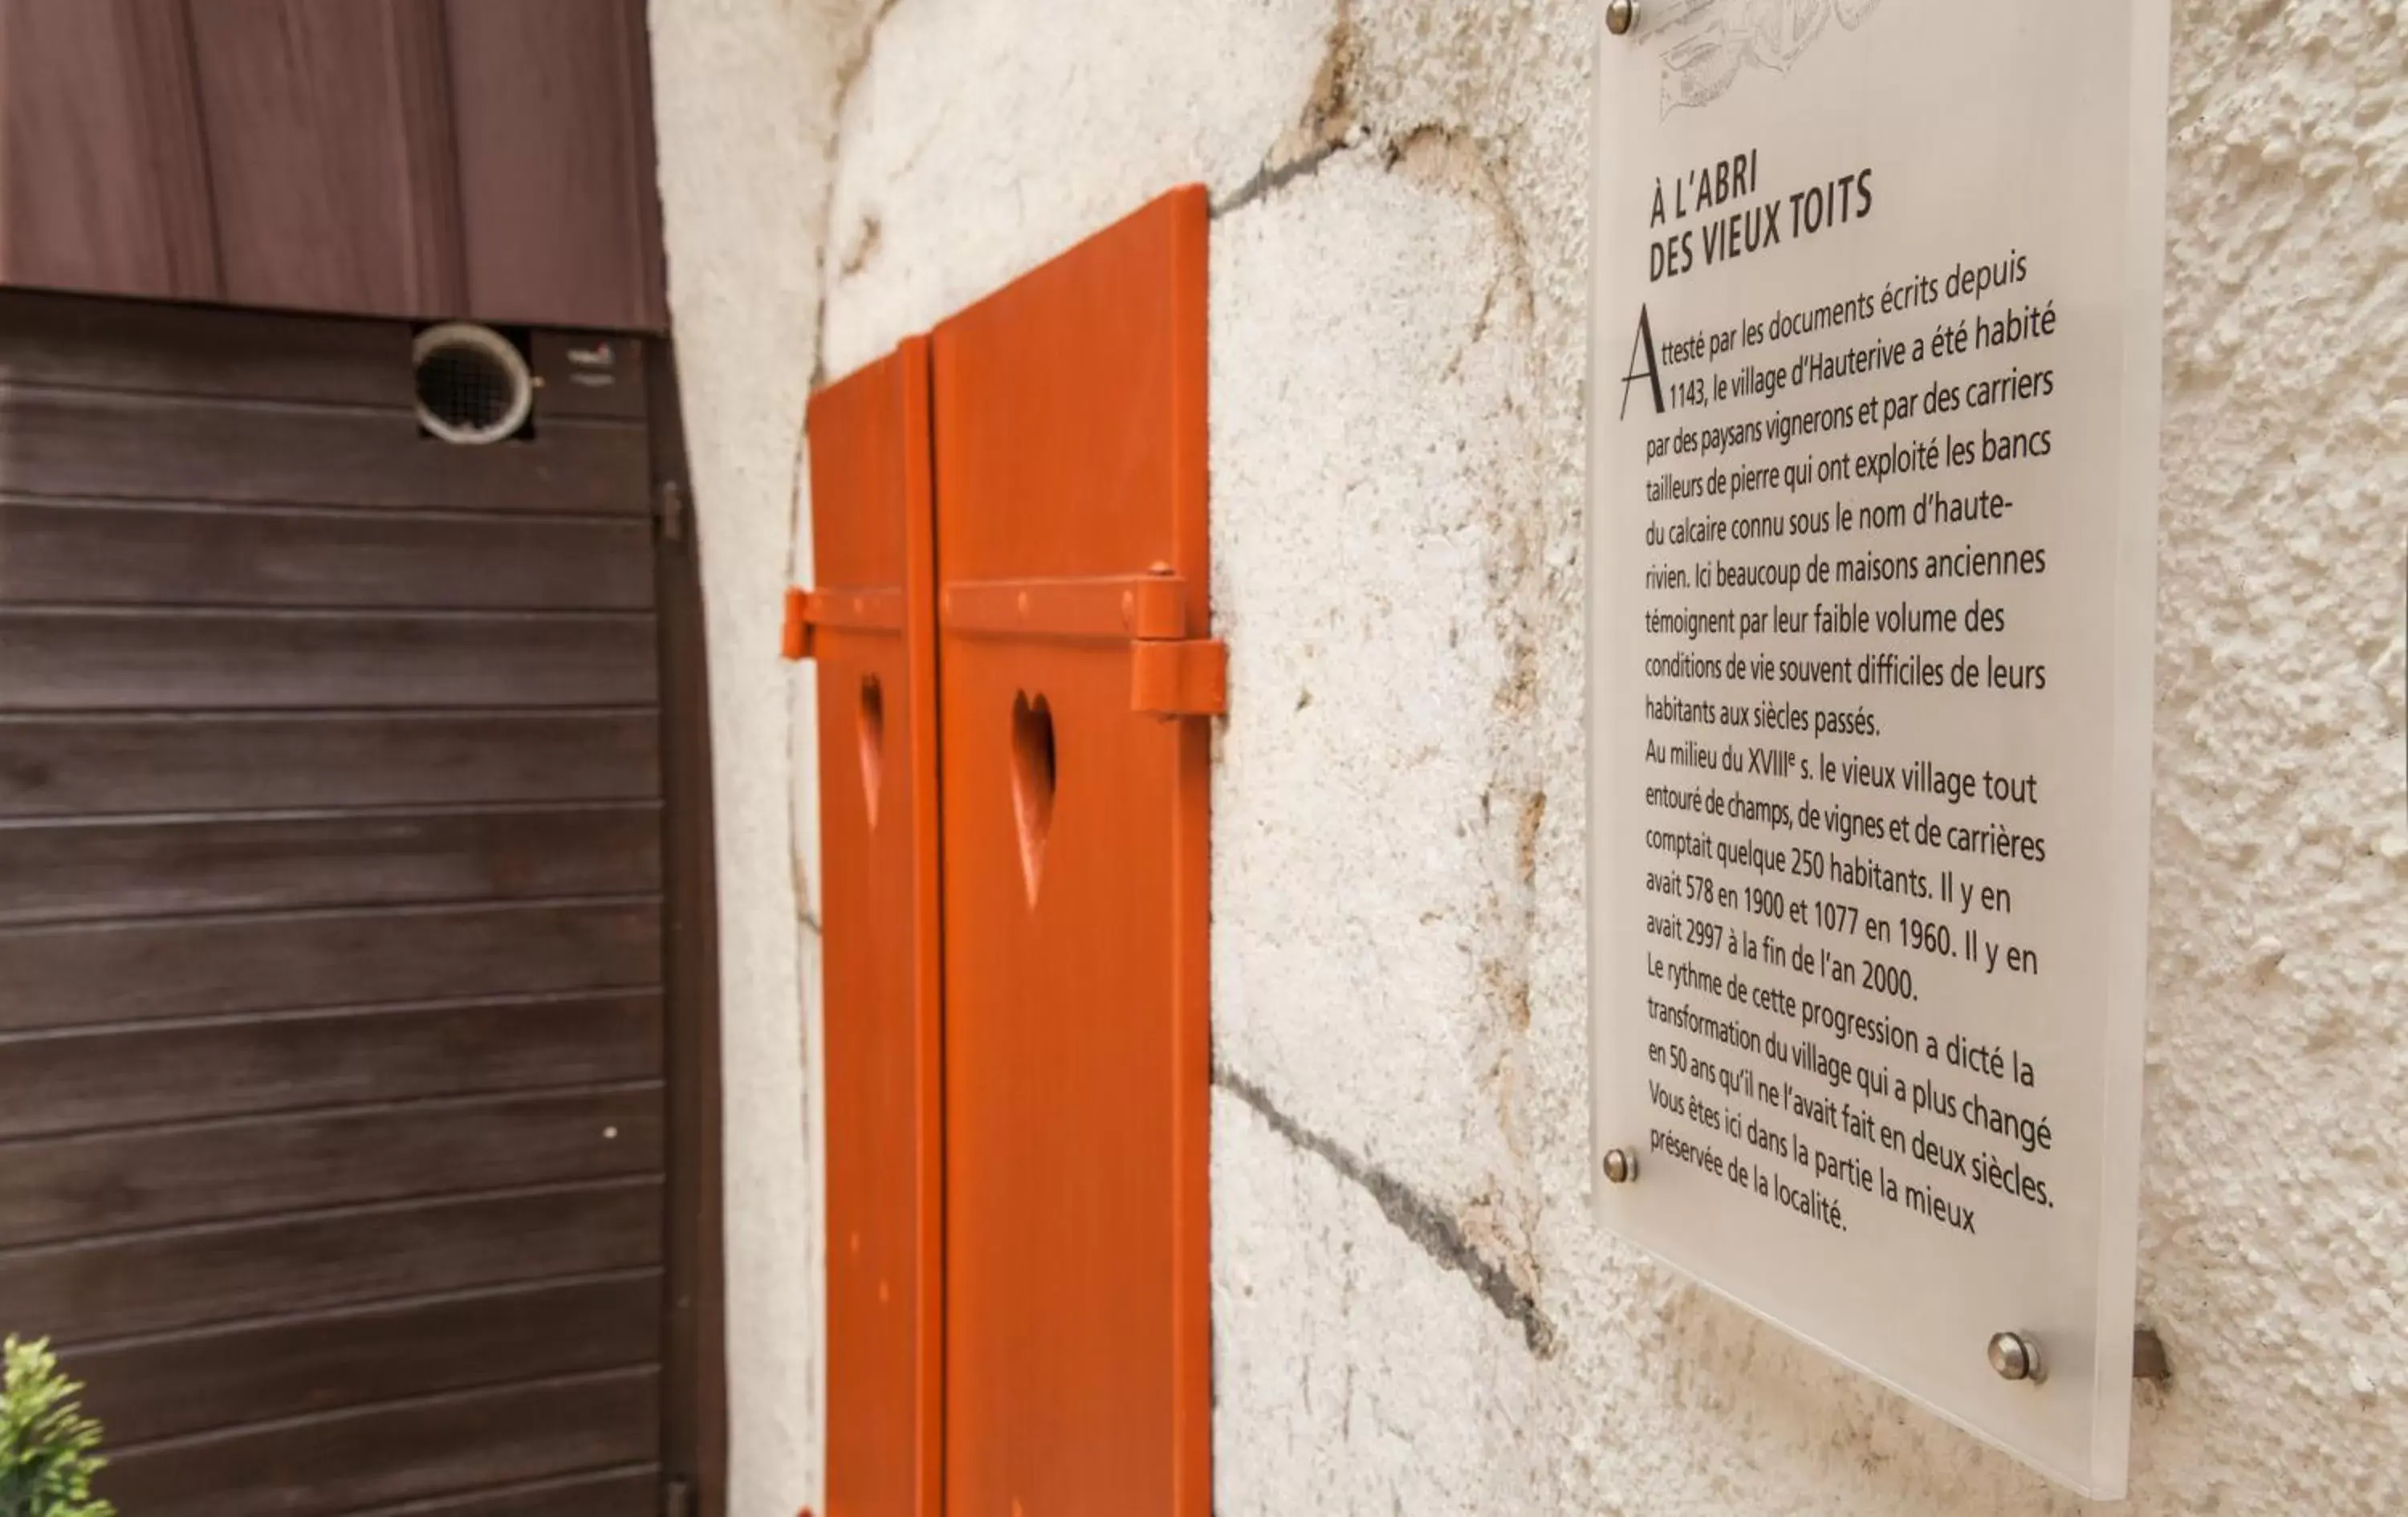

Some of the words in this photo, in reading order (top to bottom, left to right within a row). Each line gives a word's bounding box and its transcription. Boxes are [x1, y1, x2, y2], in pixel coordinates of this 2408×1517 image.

[1649, 177, 1666, 230] À
[1675, 148, 1758, 219] L’ABRI
[1649, 230, 1694, 283] DES
[1702, 199, 1781, 266] VIEUX
[1788, 167, 1873, 239] TOITS
[1709, 328, 1738, 363] par
[1741, 317, 1764, 348] les
[1768, 291, 1874, 341] documents
[1881, 274, 1938, 315] écrits
[1945, 248, 2028, 301] depuis
[1670, 377, 1709, 409] 1143,
[1713, 372, 1728, 401] le
[1731, 364, 1788, 400] village
[1791, 337, 1906, 386] d’Hauterive
[1911, 337, 1925, 363] a
[1930, 319, 1969, 358] été
[1975, 299, 2056, 350] habité
[1646, 436, 1670, 466] par
[1673, 426, 1698, 455] des
[1701, 420, 1763, 458] paysans
[1765, 404, 1854, 446] vignerons
[1857, 396, 1879, 426] et
[1883, 392, 1919, 431] par
[1922, 380, 1961, 416] des
[1965, 366, 2054, 409] carriers
[1645, 473, 1704, 502] tailleurs
[1706, 466, 1727, 496] de
[1731, 463, 1780, 500] pierre
[1784, 453, 1812, 494] qui
[1816, 453, 1851, 483] ont
[1855, 436, 1940, 484] exploité
[1946, 433, 1975, 468] les
[1982, 428, 2052, 463] bancs
[1645, 519, 1665, 547] du
[1668, 514, 1727, 545] calcaire
[1731, 515, 1784, 540] connu
[1788, 510, 1830, 536] sous
[1836, 500, 1853, 532] le
[1859, 503, 1906, 531] nom
[1913, 490, 2014, 526] d’haute-
[1645, 563, 1690, 590] rivien.
[1695, 560, 1712, 588] Ici
[1716, 559, 1801, 592] beaucoup
[1805, 553, 1831, 584] de
[1836, 550, 1919, 583] maisons
[1924, 543, 2046, 579] anciennes
[1645, 607, 1736, 641] témoignent
[1739, 612, 1769, 641] par
[1773, 604, 1809, 634] leur
[1813, 602, 1870, 634] faible
[1875, 600, 1958, 633] volume
[1964, 598, 2005, 633] des
[1645, 650, 1723, 680] conditions
[1725, 651, 1747, 681] de
[1750, 652, 1775, 681] vie
[1779, 657, 1853, 685] souvent
[1857, 653, 1944, 687] difficiles
[1950, 654, 1980, 689] de
[1987, 654, 2046, 690] leurs
[1645, 693, 1716, 725] habitants
[1719, 705, 1750, 726] aux
[1753, 699, 1809, 732] siècles
[1814, 706, 1881, 740] passés.
[1645, 738, 1666, 764] Au
[1670, 740, 1718, 770] milieu
[1721, 744, 1743, 773] du
[1800, 758, 1814, 780] s.
[1820, 752, 1837, 783] le
[1841, 754, 1896, 790] vieux
[1901, 760, 1977, 805] village
[1982, 770, 2038, 805] tout
[1645, 784, 1702, 813] entouré
[1704, 787, 1725, 816] de
[1727, 790, 1793, 831] champs,
[1797, 799, 1821, 831] de
[1824, 803, 1885, 843] vignes
[1889, 815, 1910, 844] et
[1914, 813, 1942, 848] de
[1946, 822, 2046, 863] carrières
[1645, 828, 1714, 860] comptait
[1716, 838, 1786, 876] quelque
[1791, 847, 1824, 880] 250
[1829, 851, 1934, 900] habitants.
[1941, 870, 1953, 903] Il
[1959, 882, 1974, 915] y
[1980, 885, 2011, 914] en
[1645, 869, 1682, 898] avait
[1686, 873, 1714, 905] 578
[1717, 887, 1739, 910] en
[1744, 886, 1784, 920] 1900
[1788, 899, 1808, 925] et
[1814, 900, 1859, 935] 1077
[1865, 917, 1891, 944] en
[1899, 917, 1957, 958] 1960.
[1965, 929, 1978, 963] Il
[1985, 941, 1999, 974] y
[2006, 946, 2038, 975] en
[1646, 913, 1683, 942] avait
[1686, 917, 1723, 951] 2997
[1727, 927, 1738, 955] à
[1743, 930, 1758, 961] la
[1762, 934, 1787, 968] fin
[1791, 943, 1816, 975] de
[1820, 948, 1856, 986] l’an
[1861, 959, 1918, 1002] 2000.
[1647, 951, 1664, 979] Le
[1667, 960, 1723, 996] rythme
[1727, 973, 1748, 1004] de
[1752, 986, 1796, 1019] cette
[1801, 1001, 1919, 1054] progression
[1926, 1035, 1938, 1060] a
[1946, 1033, 2004, 1080] dicté
[2012, 1049, 2035, 1088] la
[1646, 995, 1761, 1054] transformation
[1764, 1031, 1788, 1064] du
[1791, 1040, 1853, 1088] village
[1857, 1065, 1889, 1099] qui
[1893, 1078, 1906, 1103] a
[1913, 1078, 1958, 1119] plus
[1962, 1092, 2052, 1153] changé
[1648, 1042, 1666, 1066] en
[1670, 1043, 1688, 1073] 50
[1690, 1057, 1716, 1084] ans
[1719, 1068, 1754, 1098] qu’il
[1758, 1081, 1780, 1108] ne
[1784, 1081, 1838, 1129] l’avait
[1841, 1103, 1876, 1144] fait
[1880, 1125, 1906, 1154] en
[1911, 1129, 1967, 1177] deux
[1971, 1151, 2054, 1209] siècles.
[1648, 1079, 1686, 1116] Vous
[1688, 1094, 1721, 1131] êtes
[1724, 1107, 1742, 1140] ici
[1747, 1117, 1788, 1158] dans
[1792, 1133, 1809, 1167] la
[1815, 1149, 1873, 1193] partie
[1879, 1166, 1898, 1203] la
[1905, 1184, 1976, 1235] mieux
[1650, 1129, 1723, 1177] préservée
[1727, 1155, 1749, 1189] de
[1754, 1164, 1769, 1198] la
[1774, 1173, 1847, 1232] localité.
